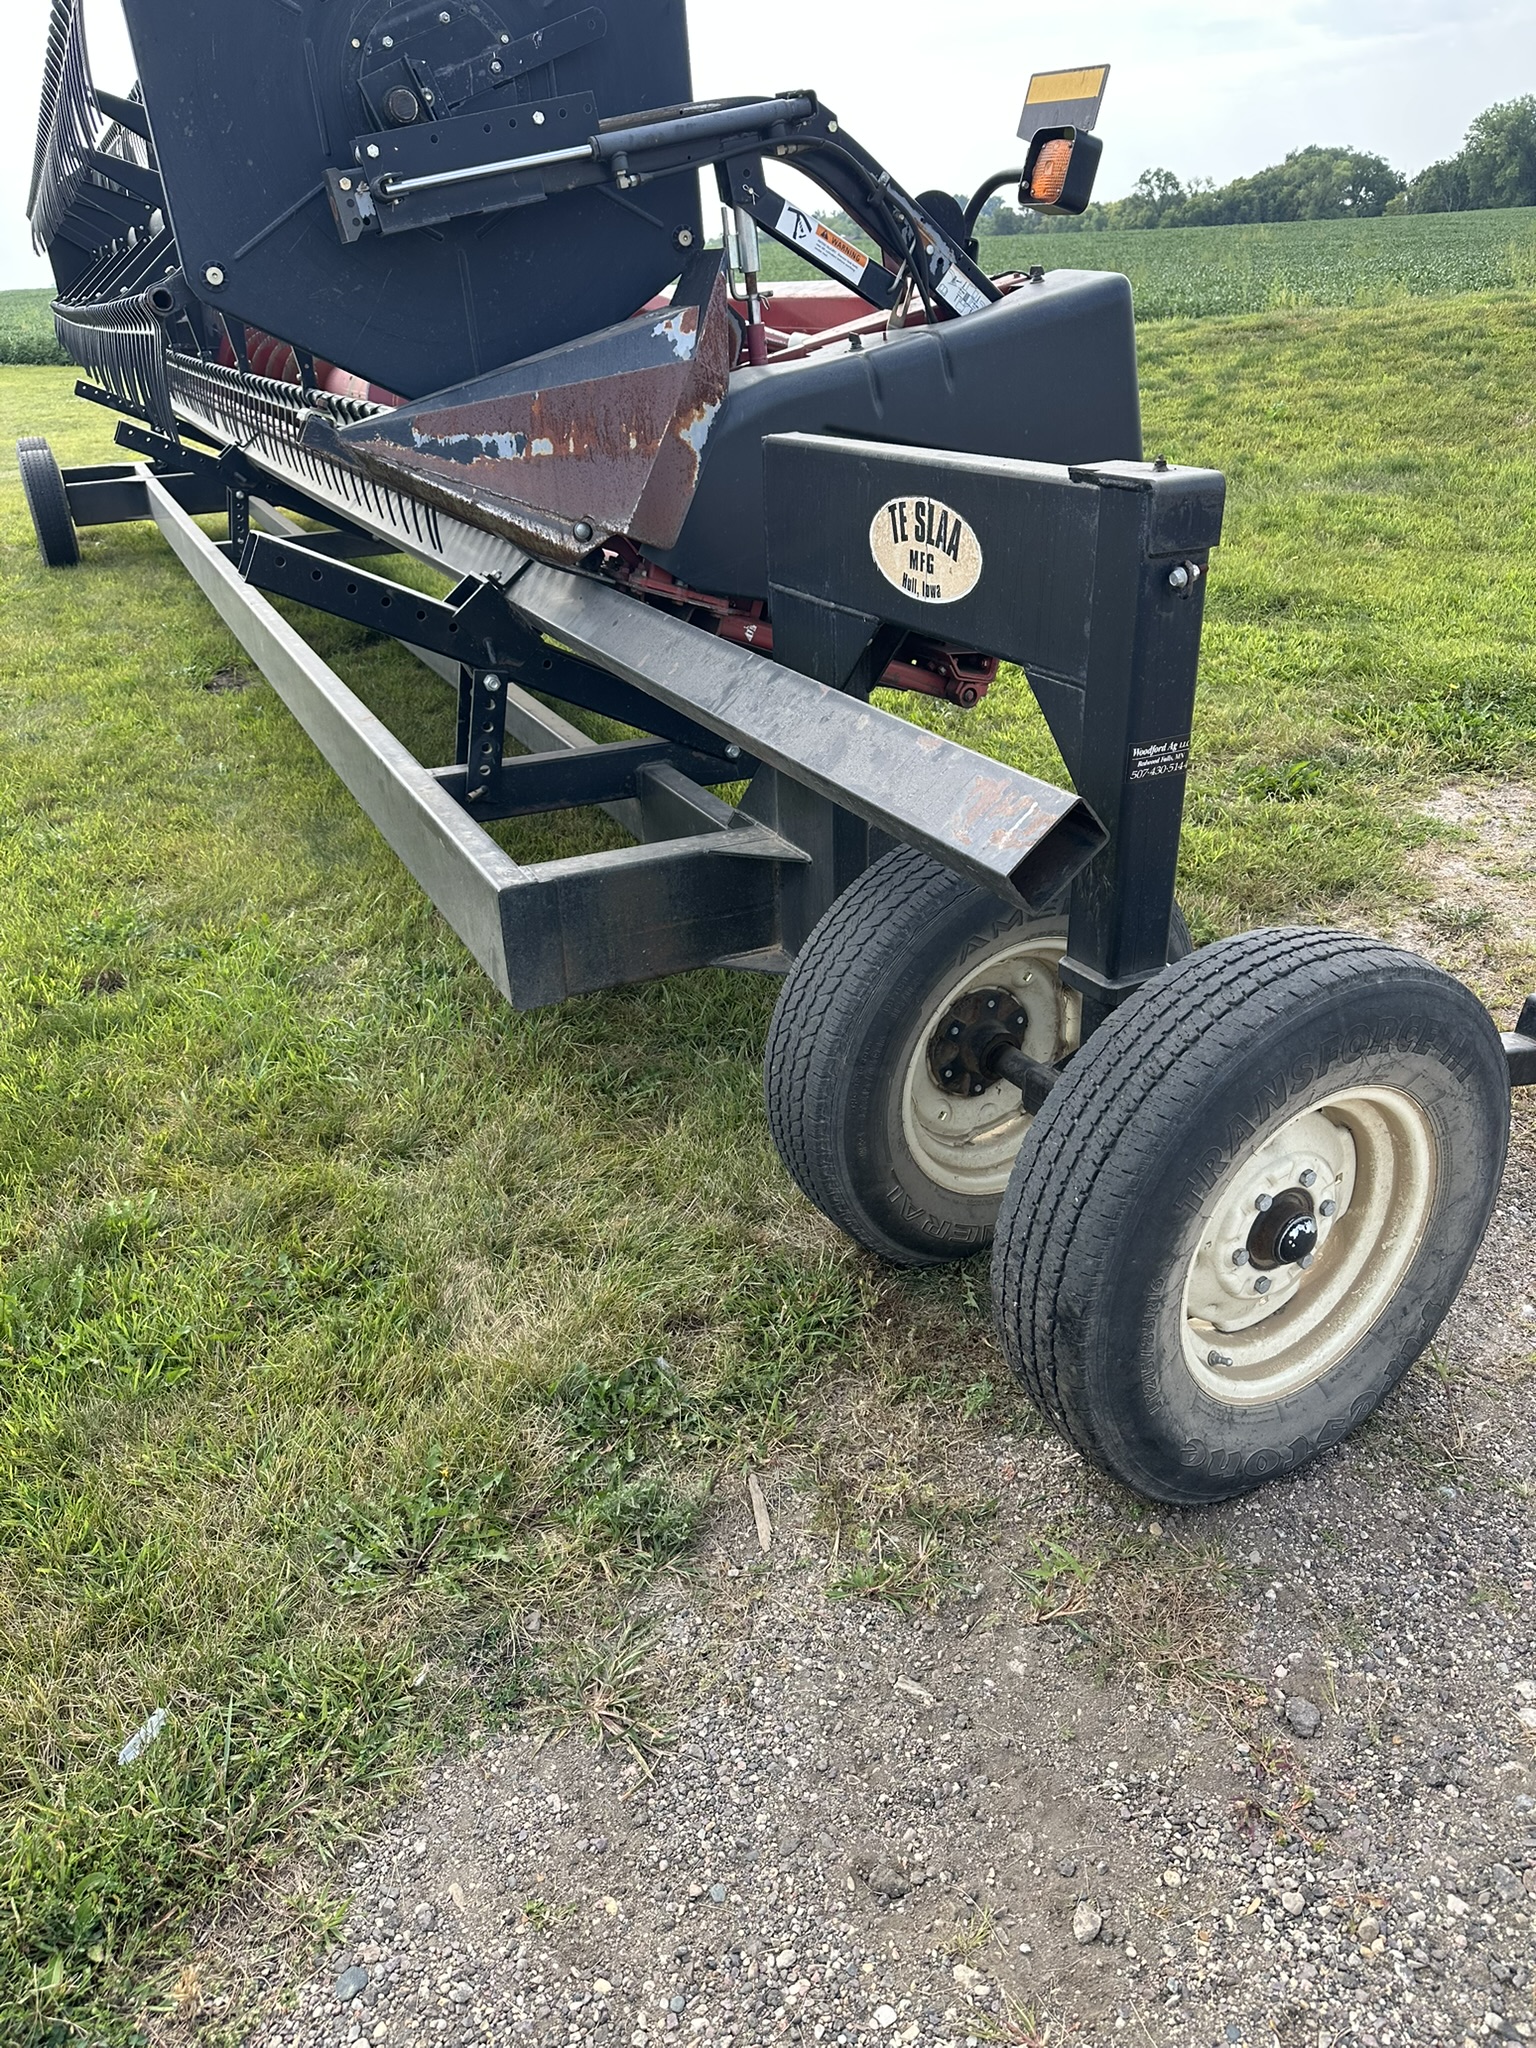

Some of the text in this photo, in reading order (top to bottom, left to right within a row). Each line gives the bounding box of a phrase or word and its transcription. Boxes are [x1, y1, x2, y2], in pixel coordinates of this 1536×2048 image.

[830, 236, 862, 263] WARNING
[888, 500, 963, 563] TE SLAA
[909, 549, 935, 575] MFG
[922, 580, 942, 599] Iowa
[1133, 743, 1167, 757] Woodford
[1167, 742, 1178, 752] Ag
